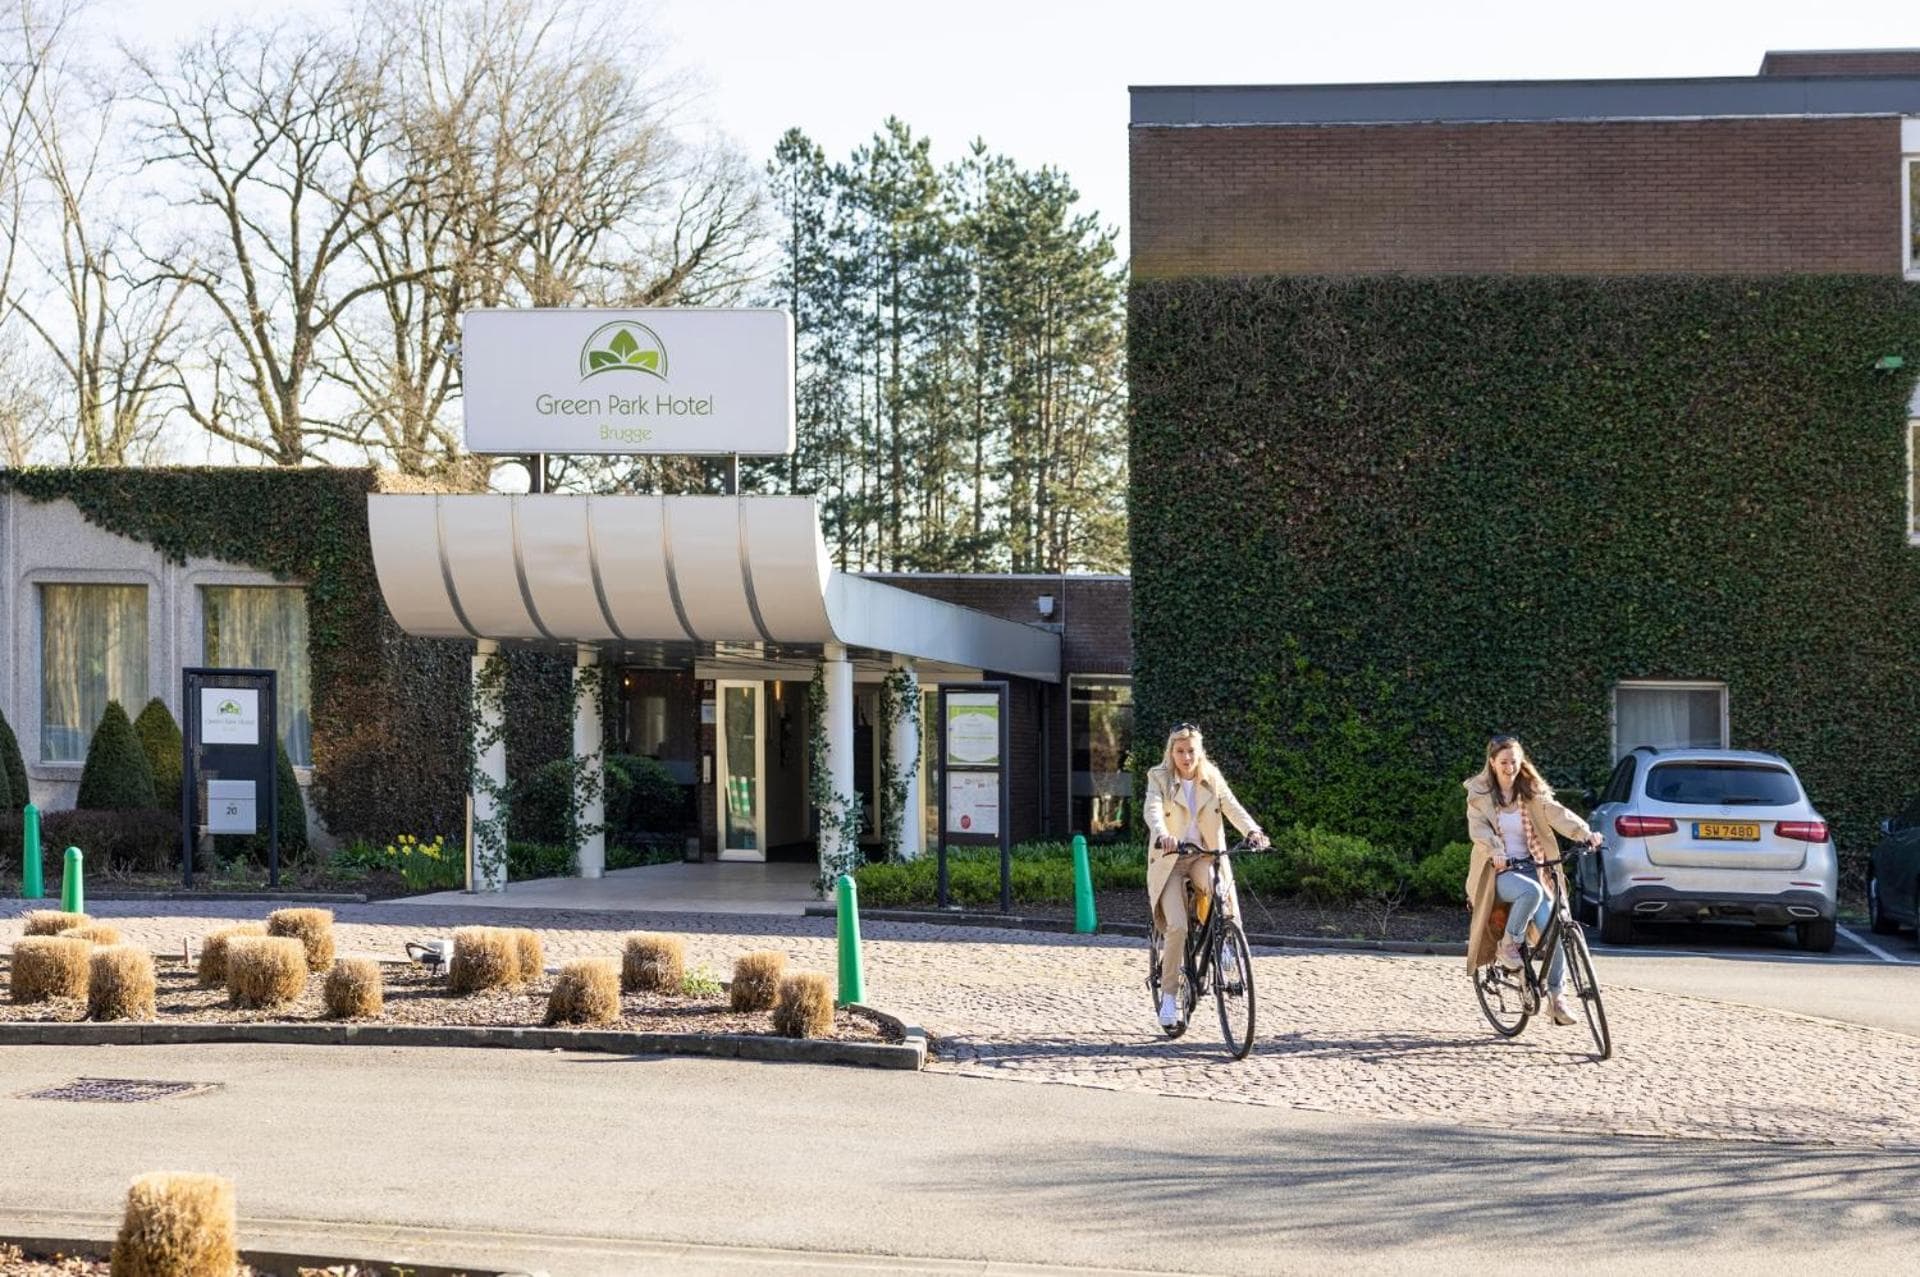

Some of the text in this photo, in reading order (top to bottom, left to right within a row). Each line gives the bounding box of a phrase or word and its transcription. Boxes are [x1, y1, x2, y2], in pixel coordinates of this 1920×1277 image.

[535, 393, 713, 415] Green Park Hotel
[600, 425, 652, 444] Brugge
[226, 806, 238, 816] 20
